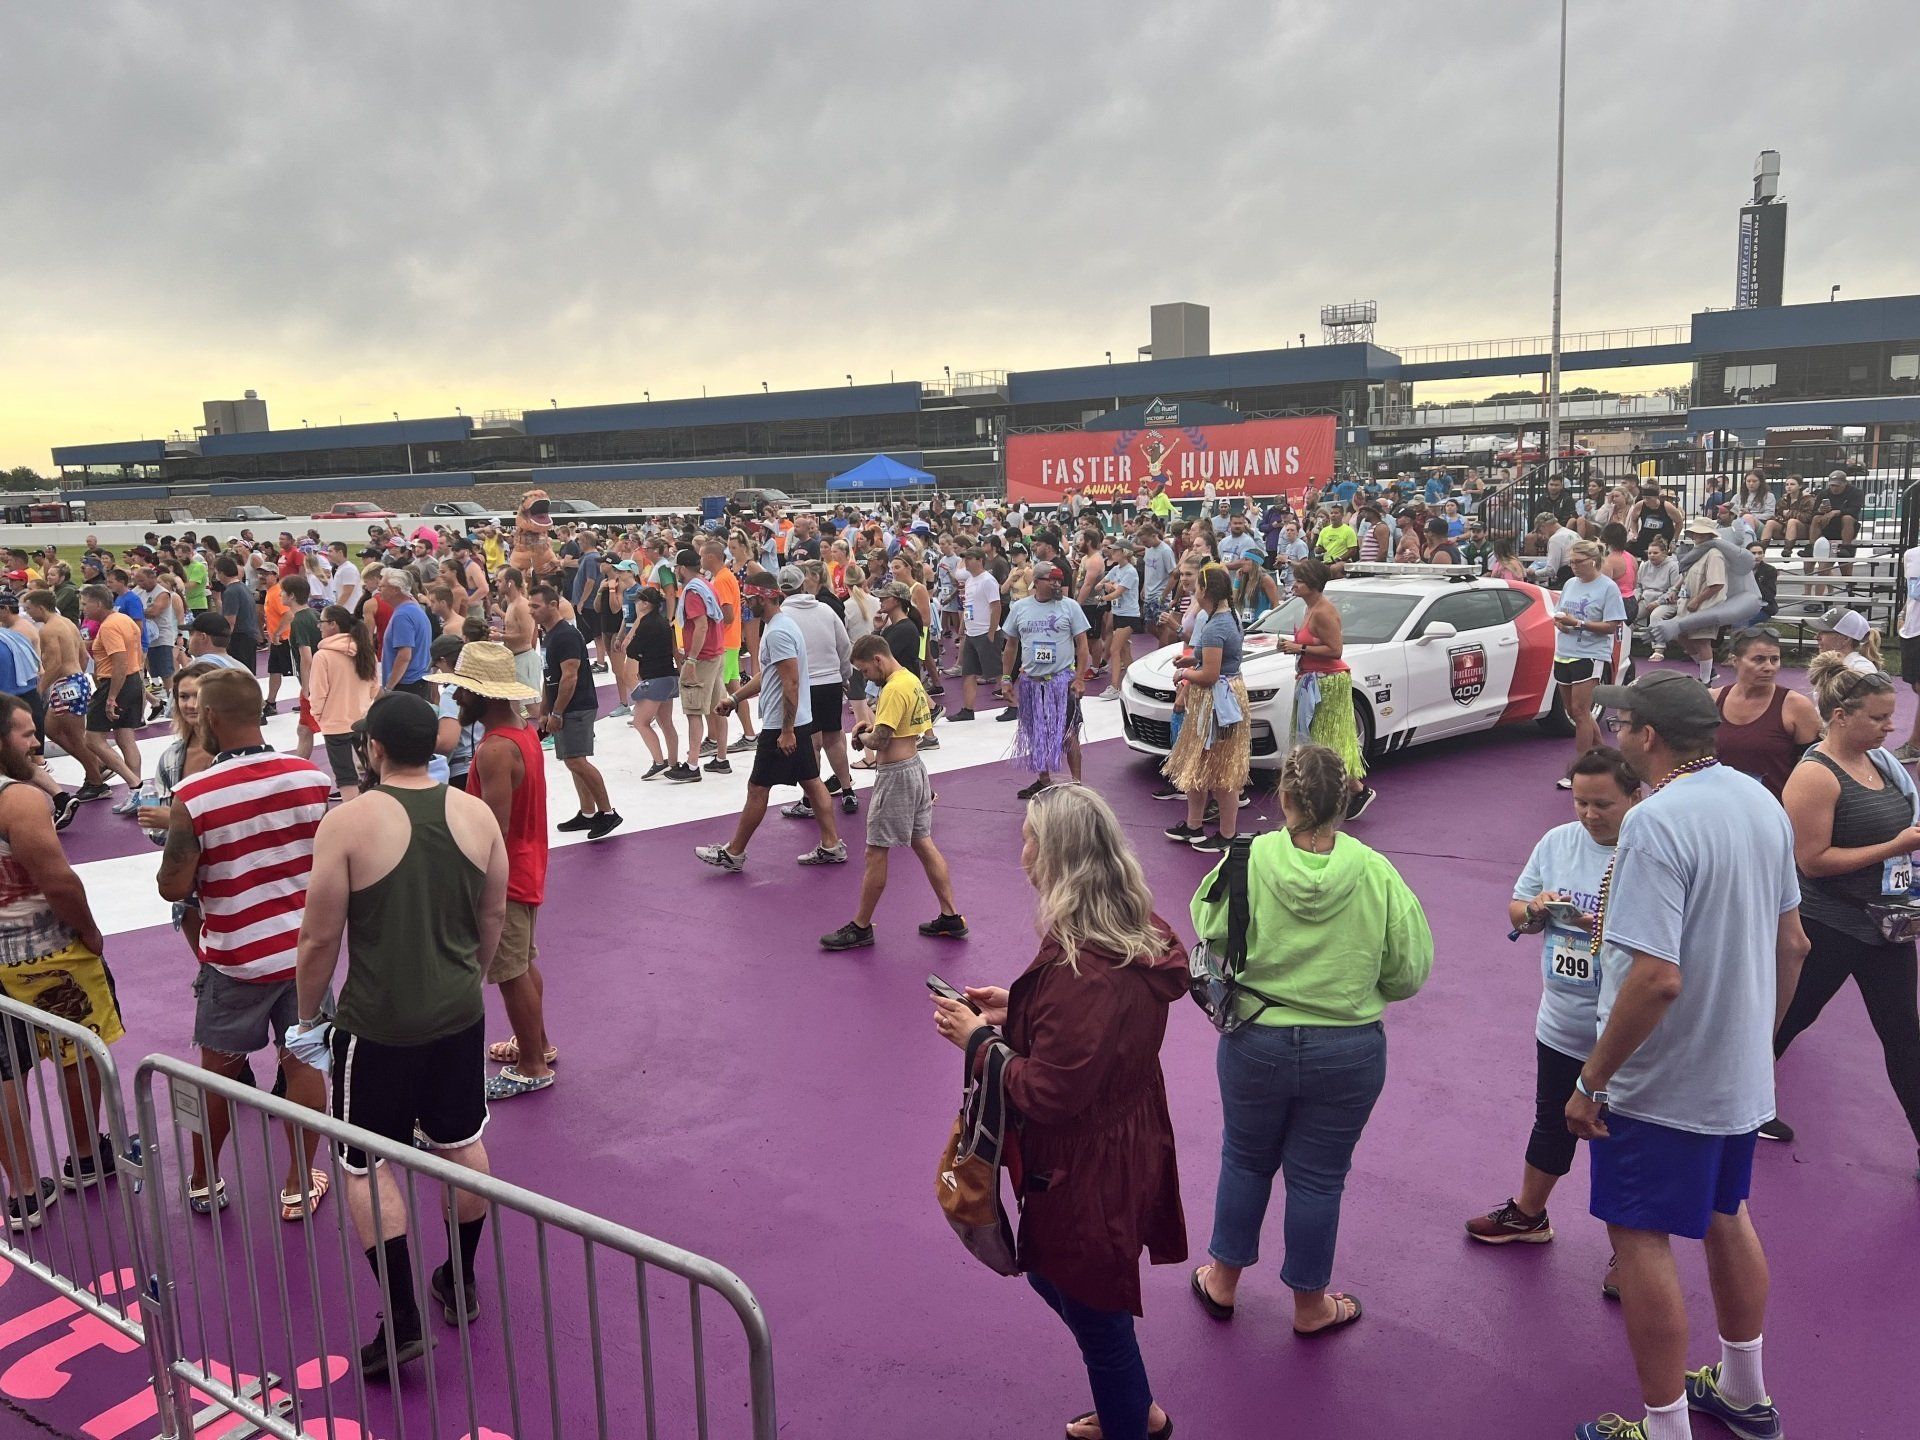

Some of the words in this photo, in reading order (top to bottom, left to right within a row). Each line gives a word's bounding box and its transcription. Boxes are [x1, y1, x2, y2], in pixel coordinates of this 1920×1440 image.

[1042, 455, 1132, 485] FASTER
[1180, 446, 1300, 479] HUMANS
[1083, 483, 1133, 495] ANNUAL
[1215, 478, 1246, 491] RUN
[1036, 652, 1050, 660] 234
[61, 690, 76, 699] 214
[1455, 685, 1481, 697] 400
[1894, 870, 1910, 889] 219
[1556, 954, 1589, 978] 299
